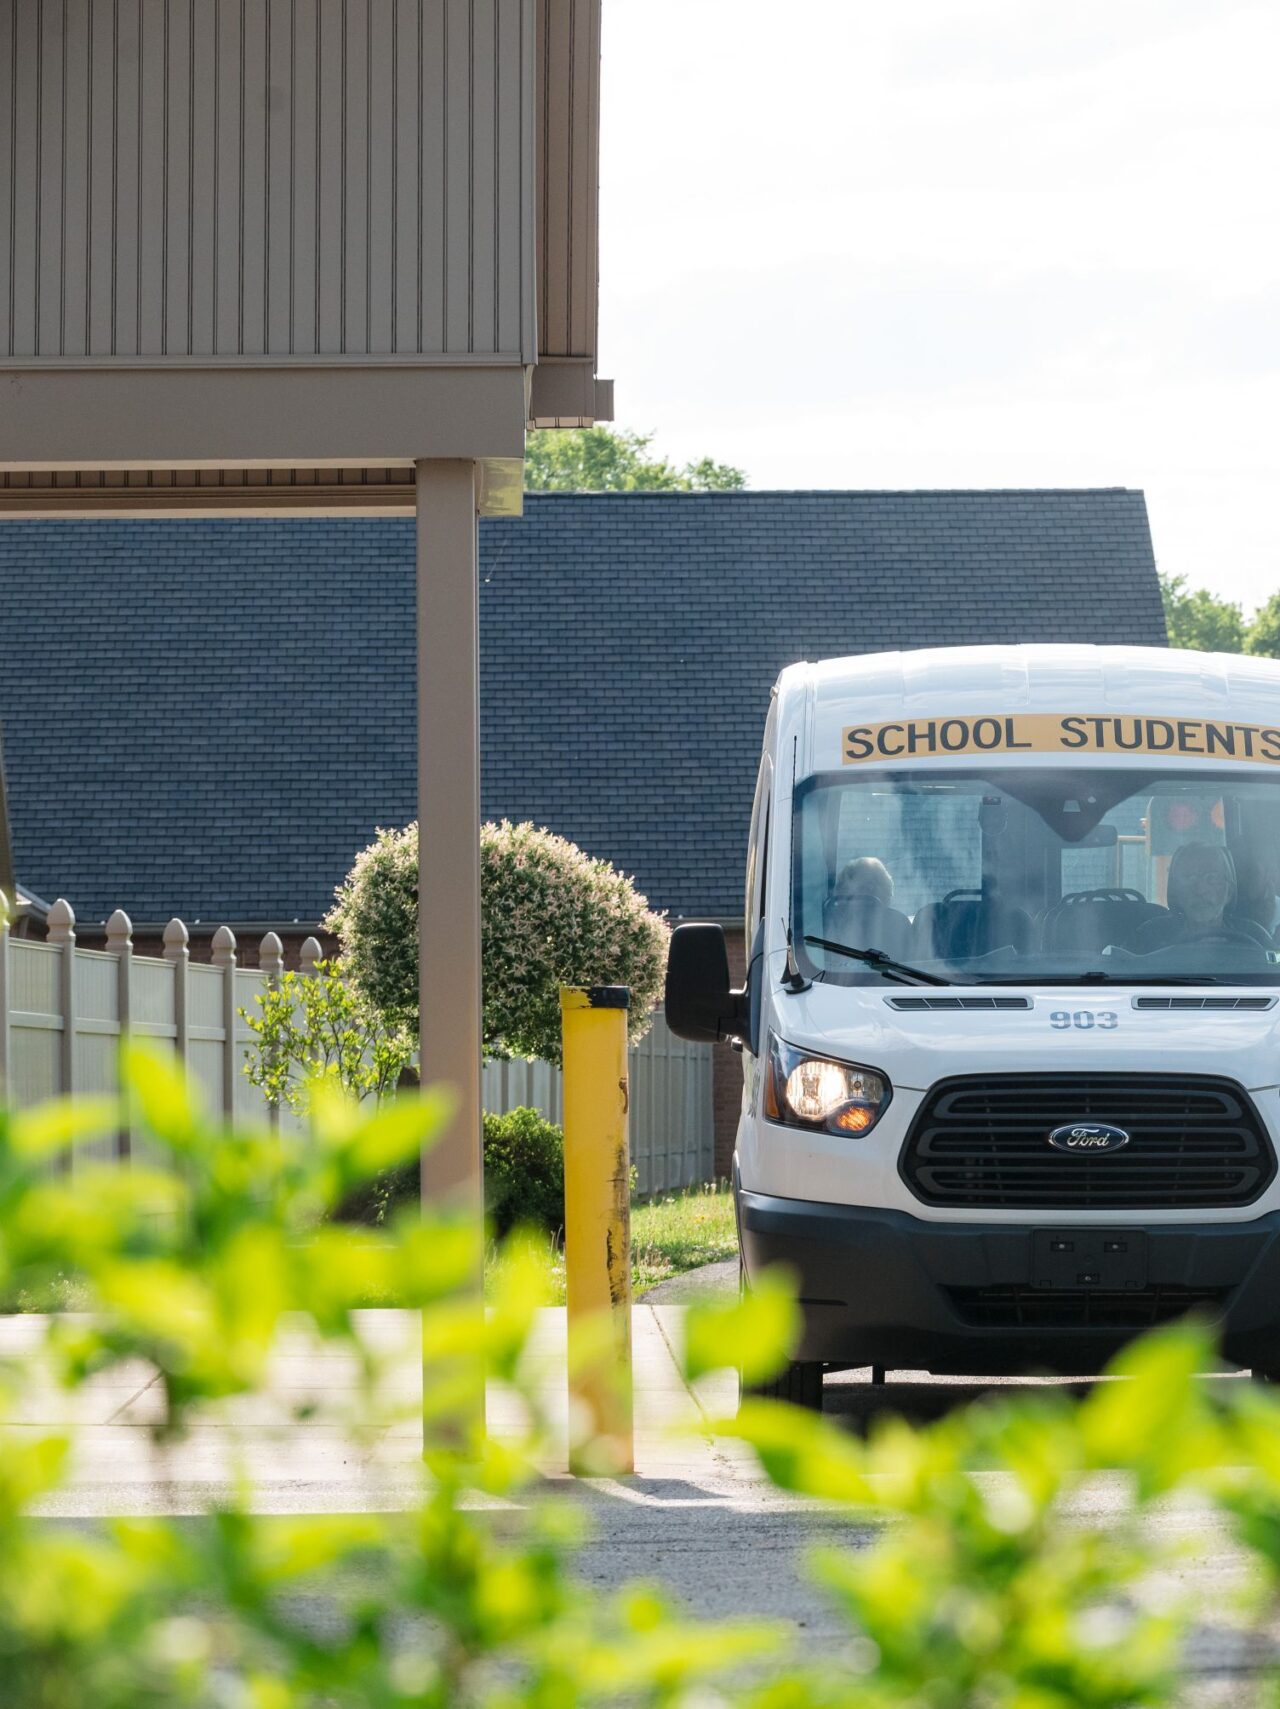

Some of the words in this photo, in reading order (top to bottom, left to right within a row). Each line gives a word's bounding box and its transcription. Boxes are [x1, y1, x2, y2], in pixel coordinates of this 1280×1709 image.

[845, 717, 1032, 760] SCHOOL
[1050, 1011, 1118, 1029] 903
[1066, 1127, 1110, 1147] Ford
